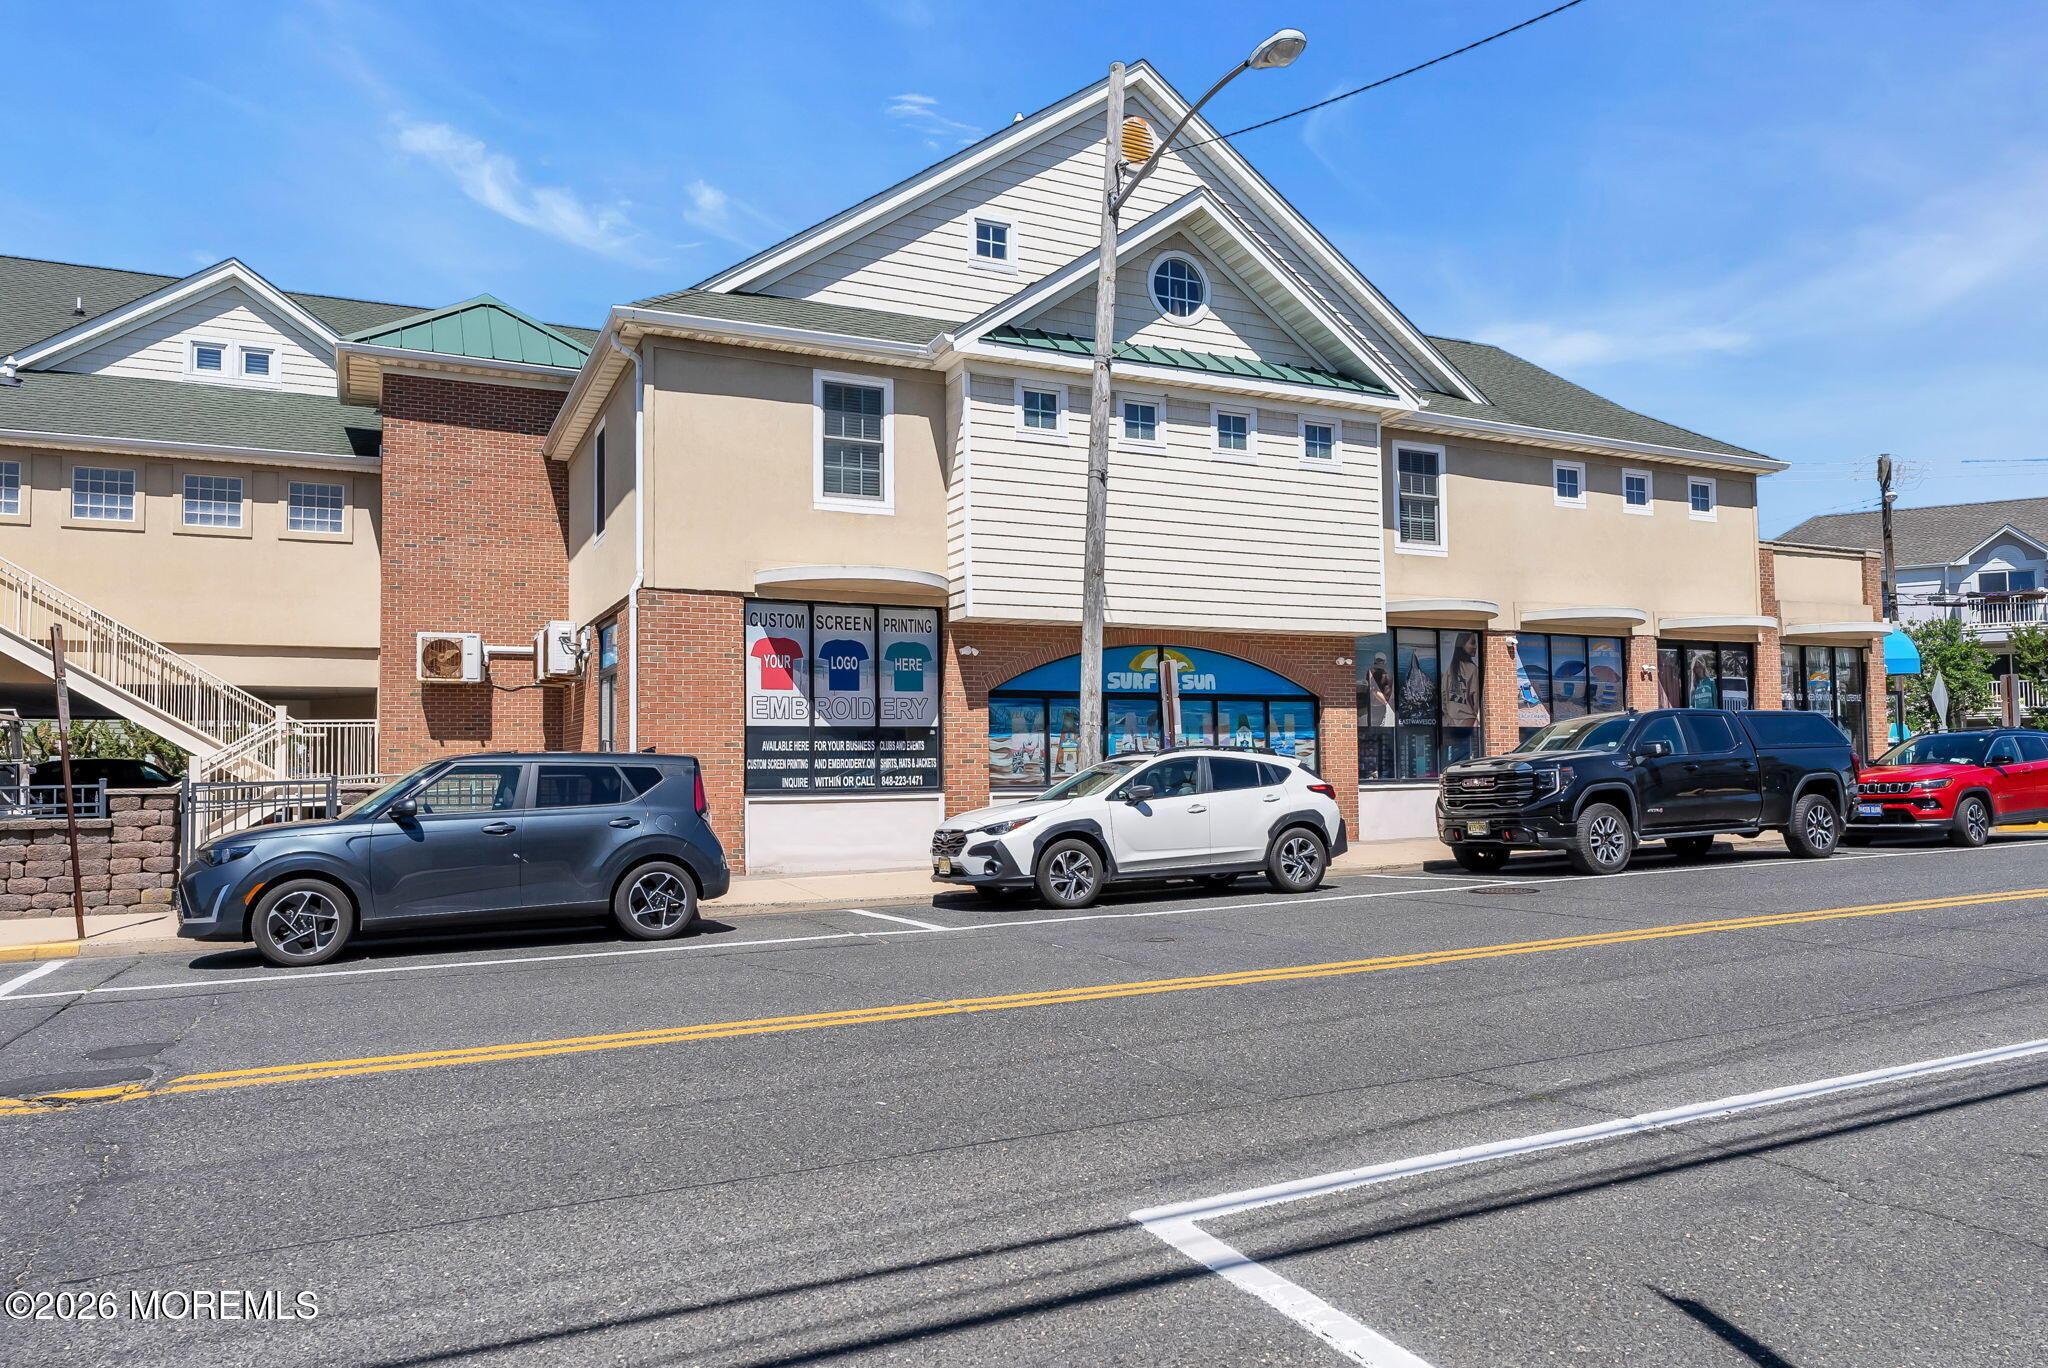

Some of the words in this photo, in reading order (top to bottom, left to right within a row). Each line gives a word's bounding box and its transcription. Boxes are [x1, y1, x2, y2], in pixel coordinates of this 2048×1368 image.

[750, 612, 805, 629] CUSTOM
[816, 615, 872, 631] SCREEN
[883, 618, 932, 634] PRINTING
[763, 654, 791, 669] YOUR
[831, 656, 858, 670] LOGO
[895, 657, 923, 672] HERE
[1107, 672, 1157, 690] SURF
[1181, 673, 1216, 691] SUN
[751, 695, 928, 720] EMBROIDERY
[762, 741, 794, 751] AVAILABLE
[795, 741, 810, 751] HERE
[814, 741, 827, 751] FOR
[828, 741, 845, 751] YOUR
[846, 741, 876, 751] BUSINESS
[880, 740, 895, 751] CLUBS
[896, 740, 906, 751] AND
[907, 740, 925, 751] EVENTS
[746, 759, 767, 769] CUSTOM
[768, 759, 786, 769] SCREEN
[787, 759, 809, 769] PRINTING
[814, 759, 827, 769] AND
[828, 759, 865, 769] EMBROIDERY
[866, 758, 876, 769] ON
[880, 758, 898, 770] SHIRTS,
[899, 758, 911, 768] HATS
[912, 758, 915, 768] &
[916, 758, 936, 768] JACKETS
[782, 777, 809, 788] INQUIRE
[814, 776, 841, 787] WITHIN
[842, 776, 854, 787] OR
[855, 776, 875, 786] CALL
[881, 775, 923, 787] 848-223-1471
